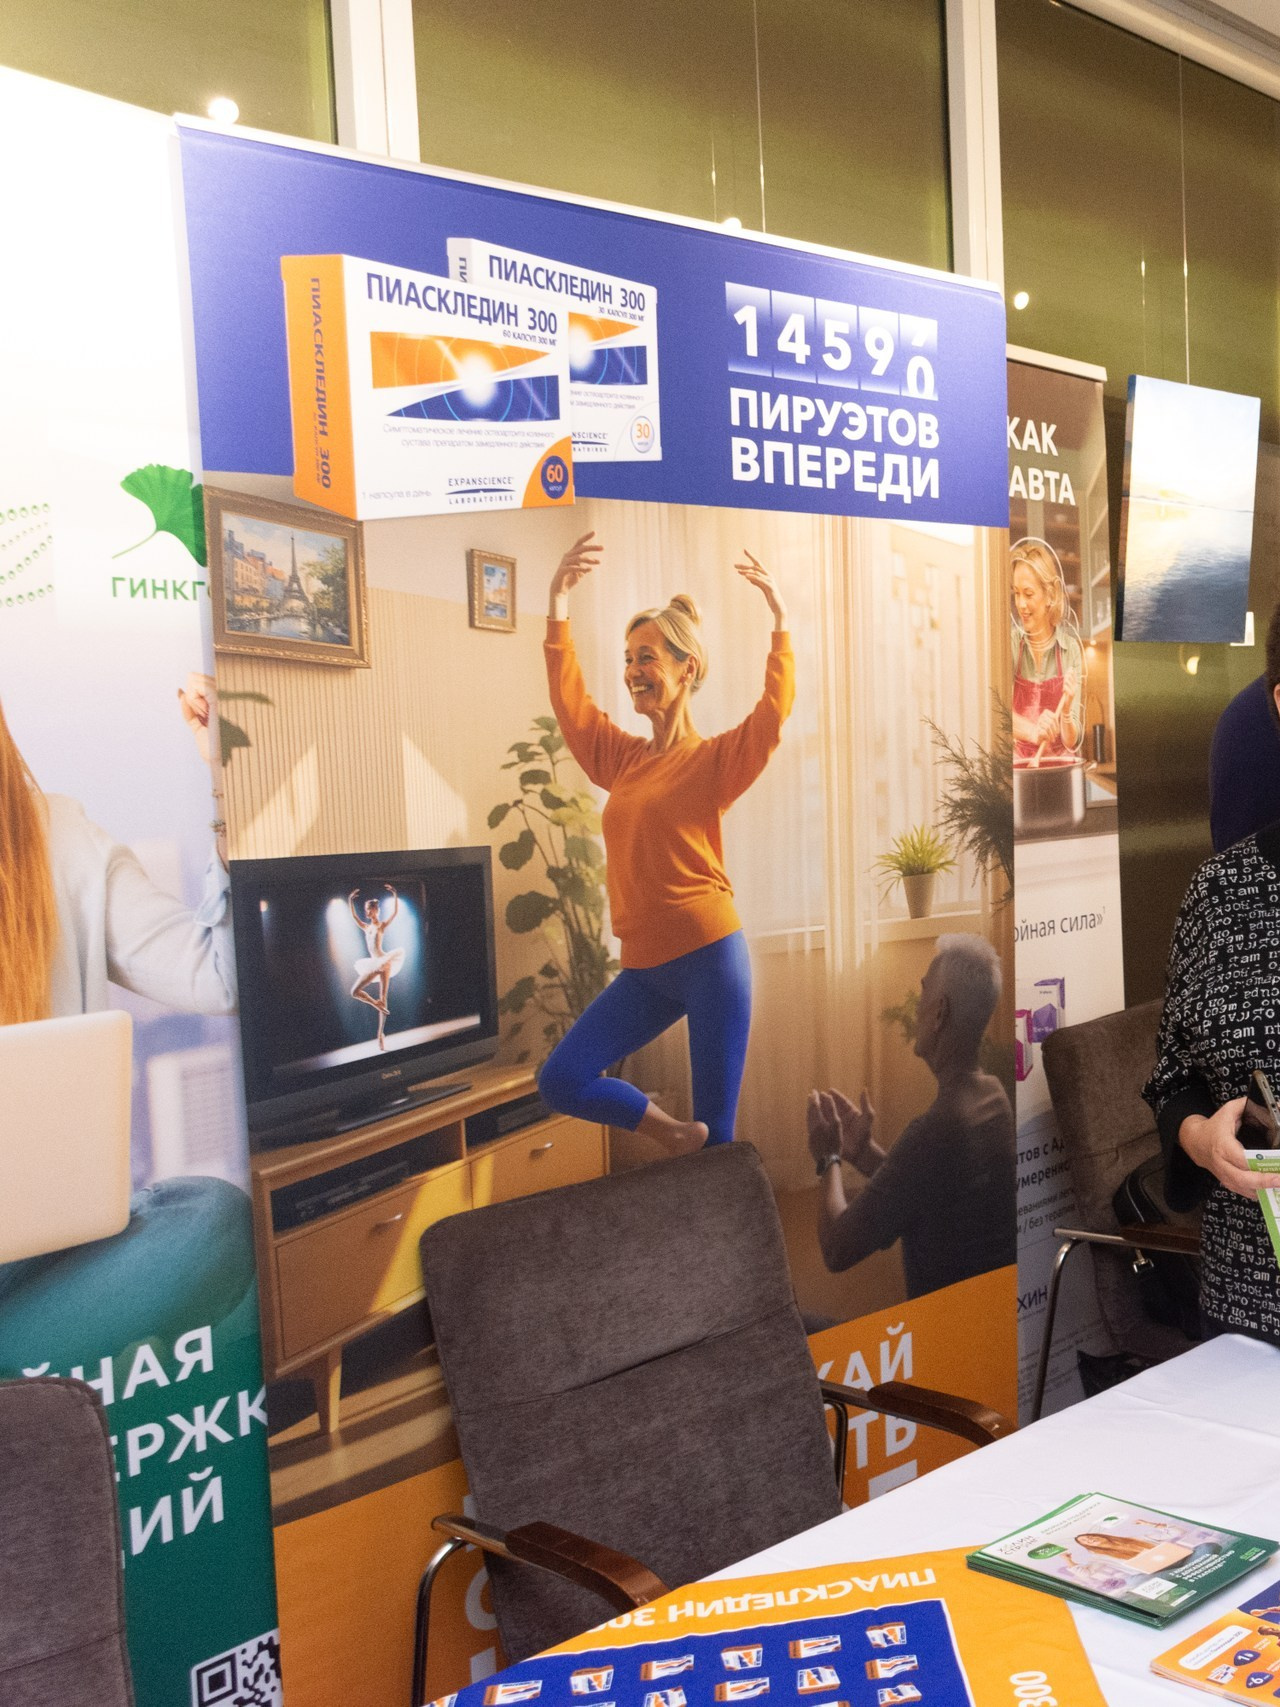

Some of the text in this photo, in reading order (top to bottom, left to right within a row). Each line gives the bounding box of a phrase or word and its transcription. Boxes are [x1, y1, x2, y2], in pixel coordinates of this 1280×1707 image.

[367, 272, 557, 335] ПИАСКЛЕДИН 300
[489, 254, 645, 312] ПИАСКЛЕДИН 300
[310, 277, 329, 437] ПИАСКЛЕДИН
[512, 332, 537, 343] КАПСУЛ
[636, 423, 650, 439] 30
[730, 386, 940, 449] ПИРУЭТОВ
[1007, 415, 1058, 457] КАК
[319, 449, 332, 489] 300
[448, 477, 513, 486] EXPANSCIENCE
[547, 464, 563, 483] 60
[731, 436, 940, 505] ВПЕРЕДИ
[449, 495, 513, 505] LABORATOIRES
[112, 576, 210, 601] ГИНКГ
[669, 1568, 937, 1624] ПИАСКЛЕДИН
